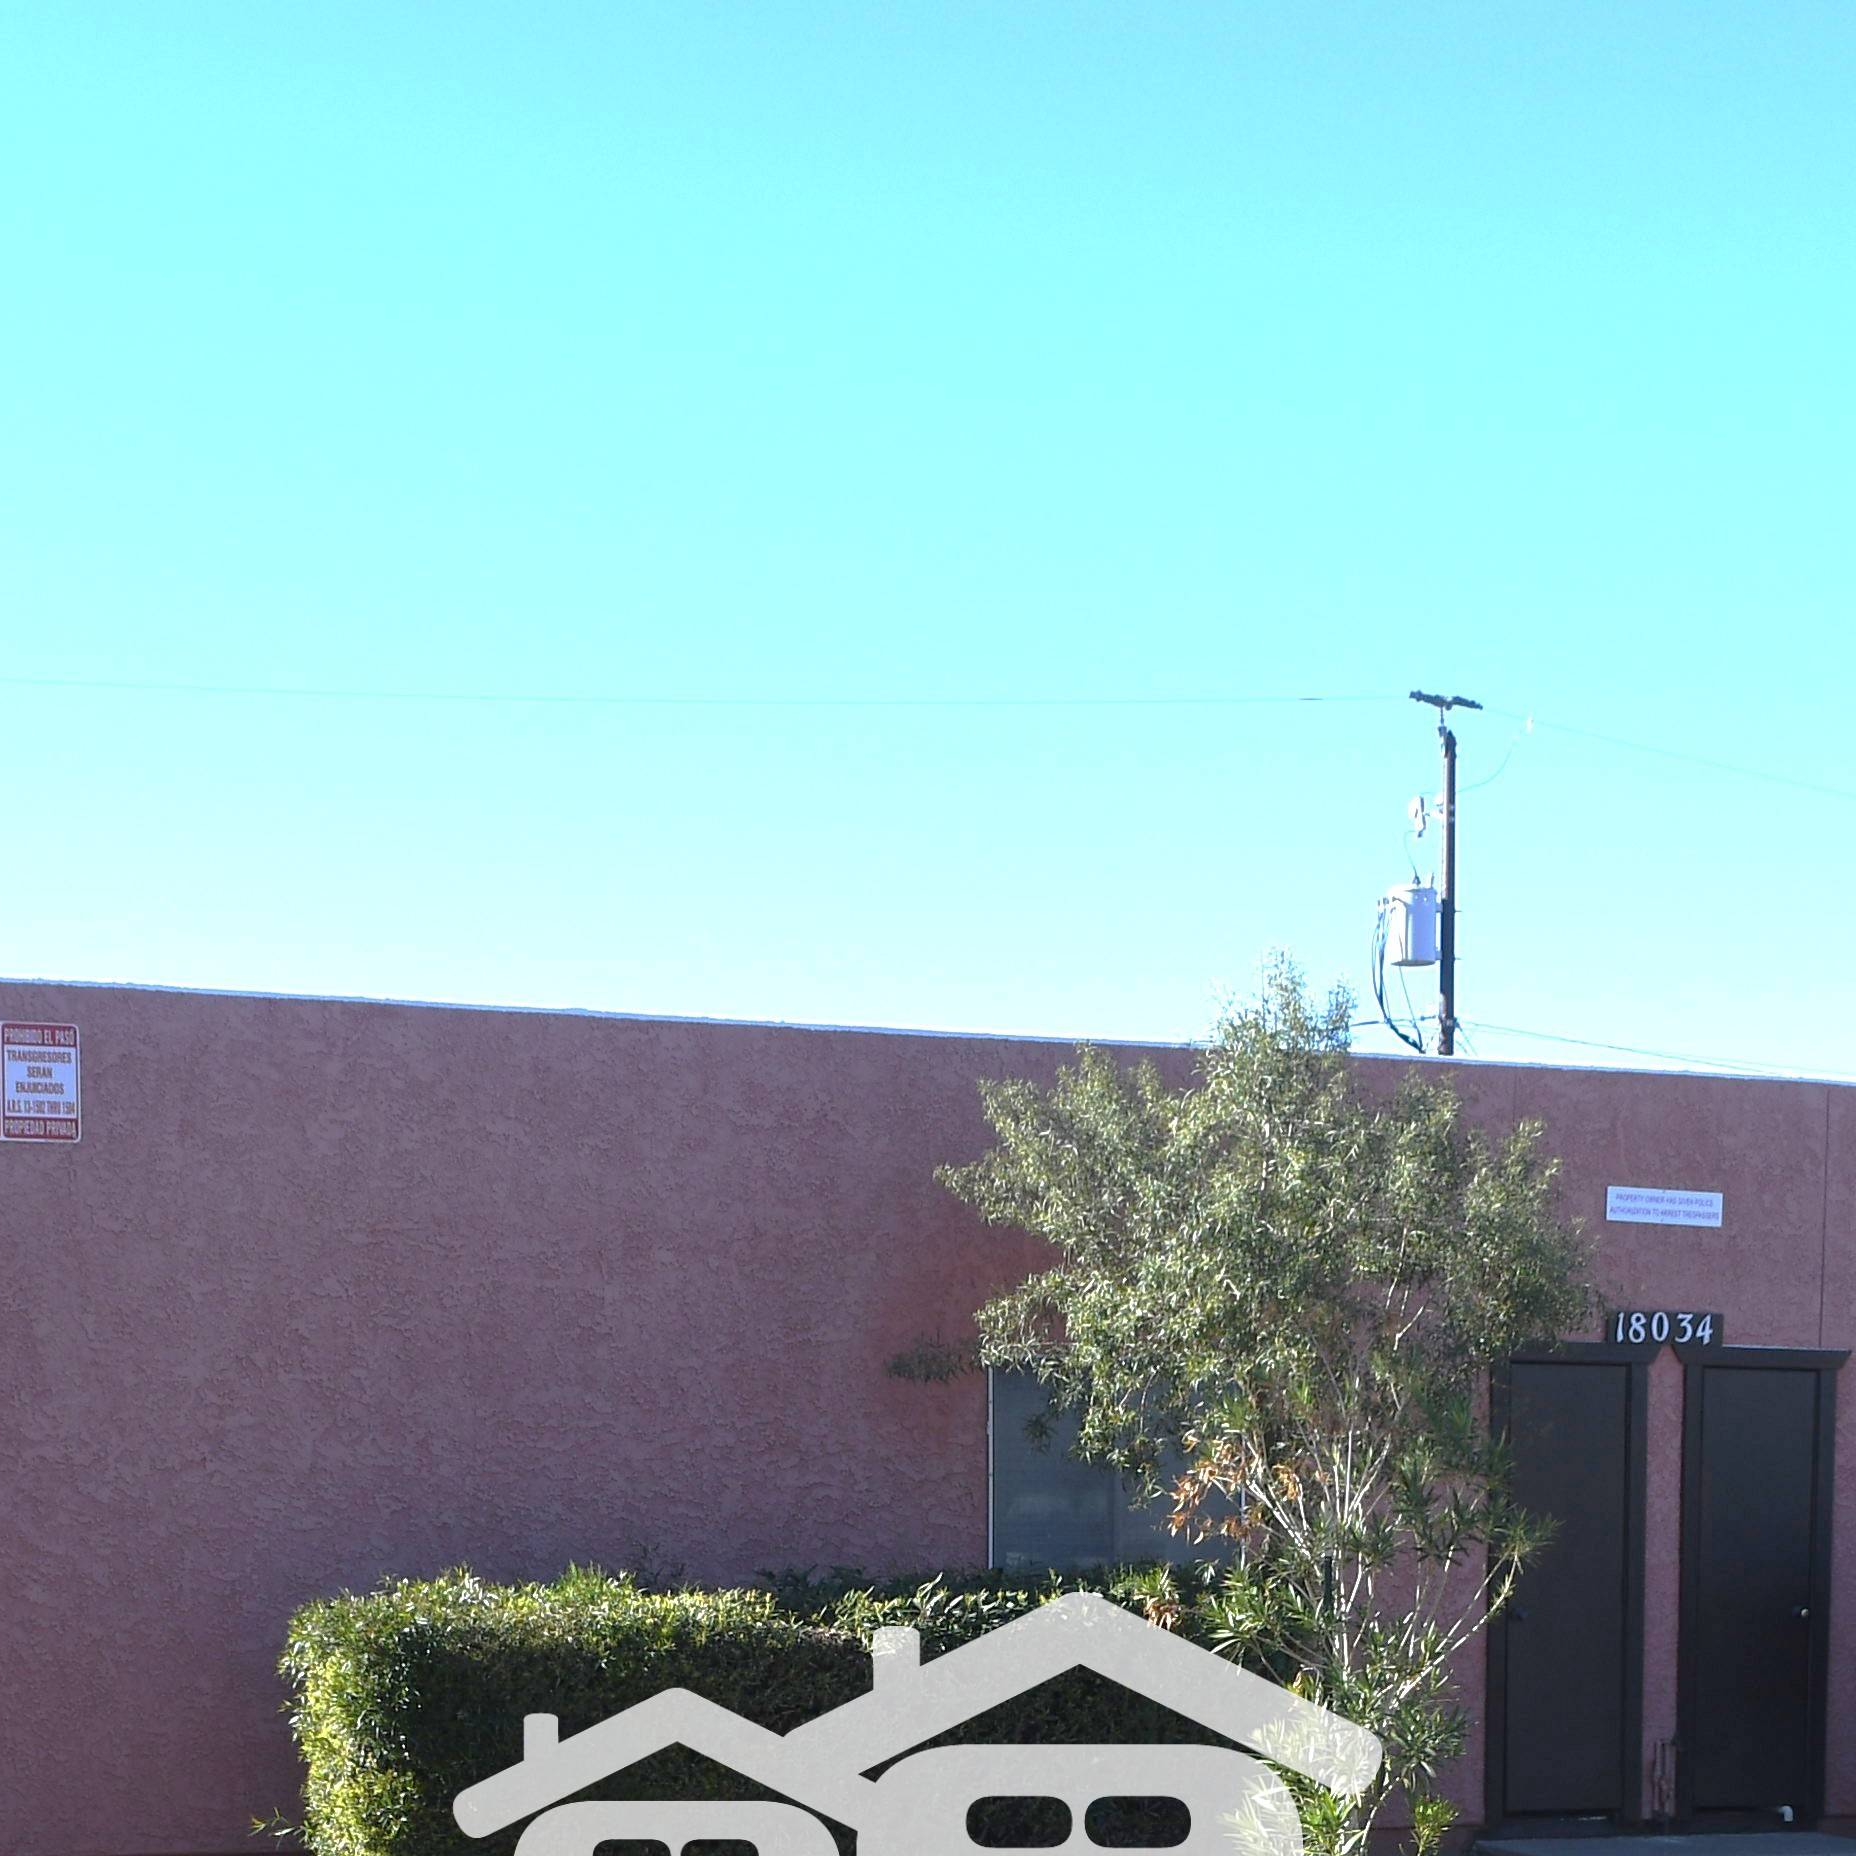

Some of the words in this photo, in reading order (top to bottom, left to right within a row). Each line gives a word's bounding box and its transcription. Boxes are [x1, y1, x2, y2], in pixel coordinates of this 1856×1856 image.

[44, 1029, 53, 1045] EL
[55, 1029, 75, 1046] PASO
[4, 1119, 45, 1136] PROPIEDAD
[46, 1120, 77, 1137] PRIVADA
[1615, 1311, 1714, 1346] 18034
